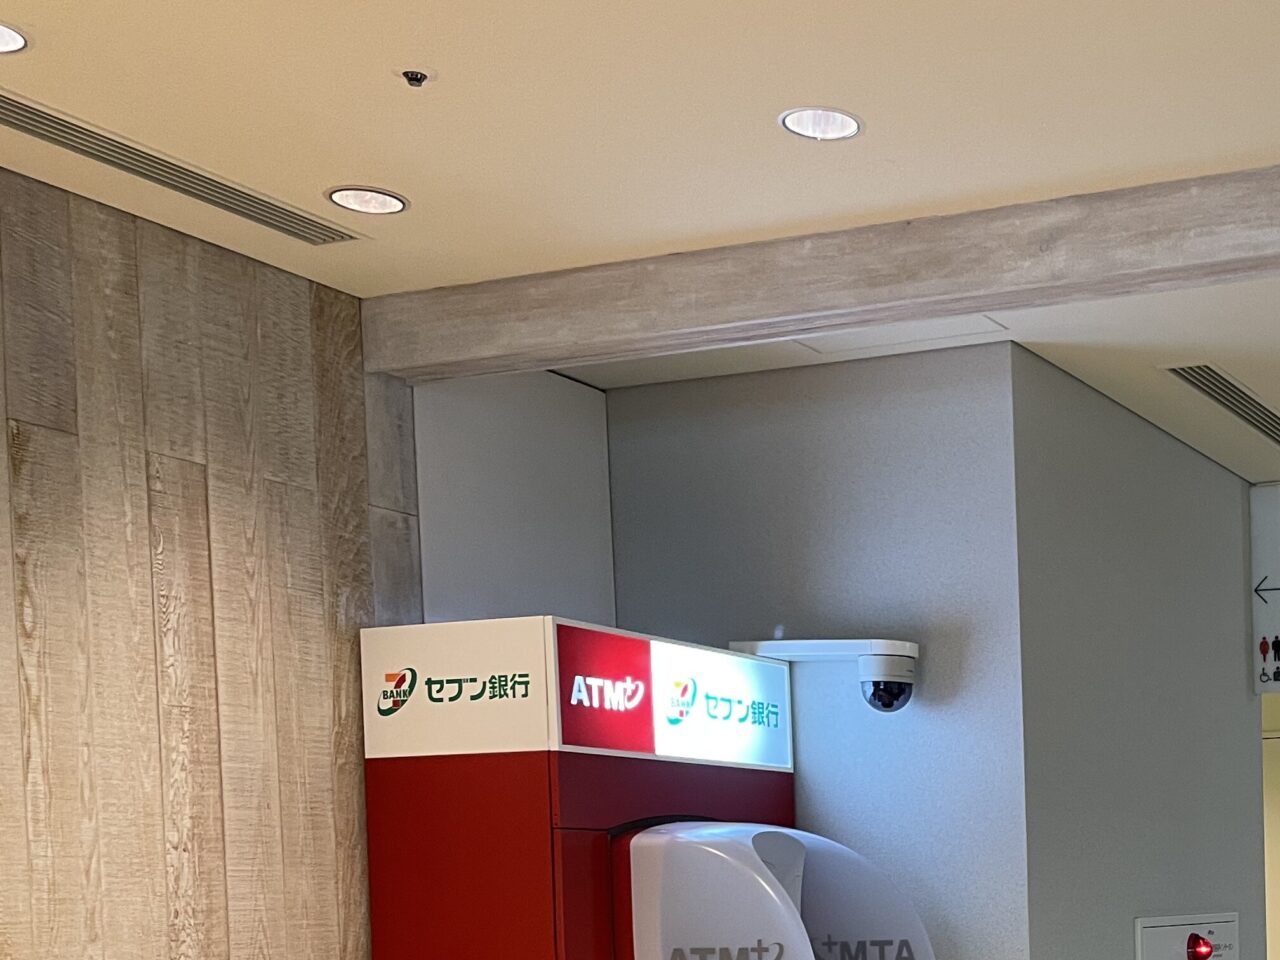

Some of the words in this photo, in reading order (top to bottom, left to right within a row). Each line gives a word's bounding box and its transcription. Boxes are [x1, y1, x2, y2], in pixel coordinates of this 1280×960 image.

[382, 688, 410, 700] BANK
[424, 673, 530, 703] セブン銀行
[703, 691, 780, 729] セブン銀行
